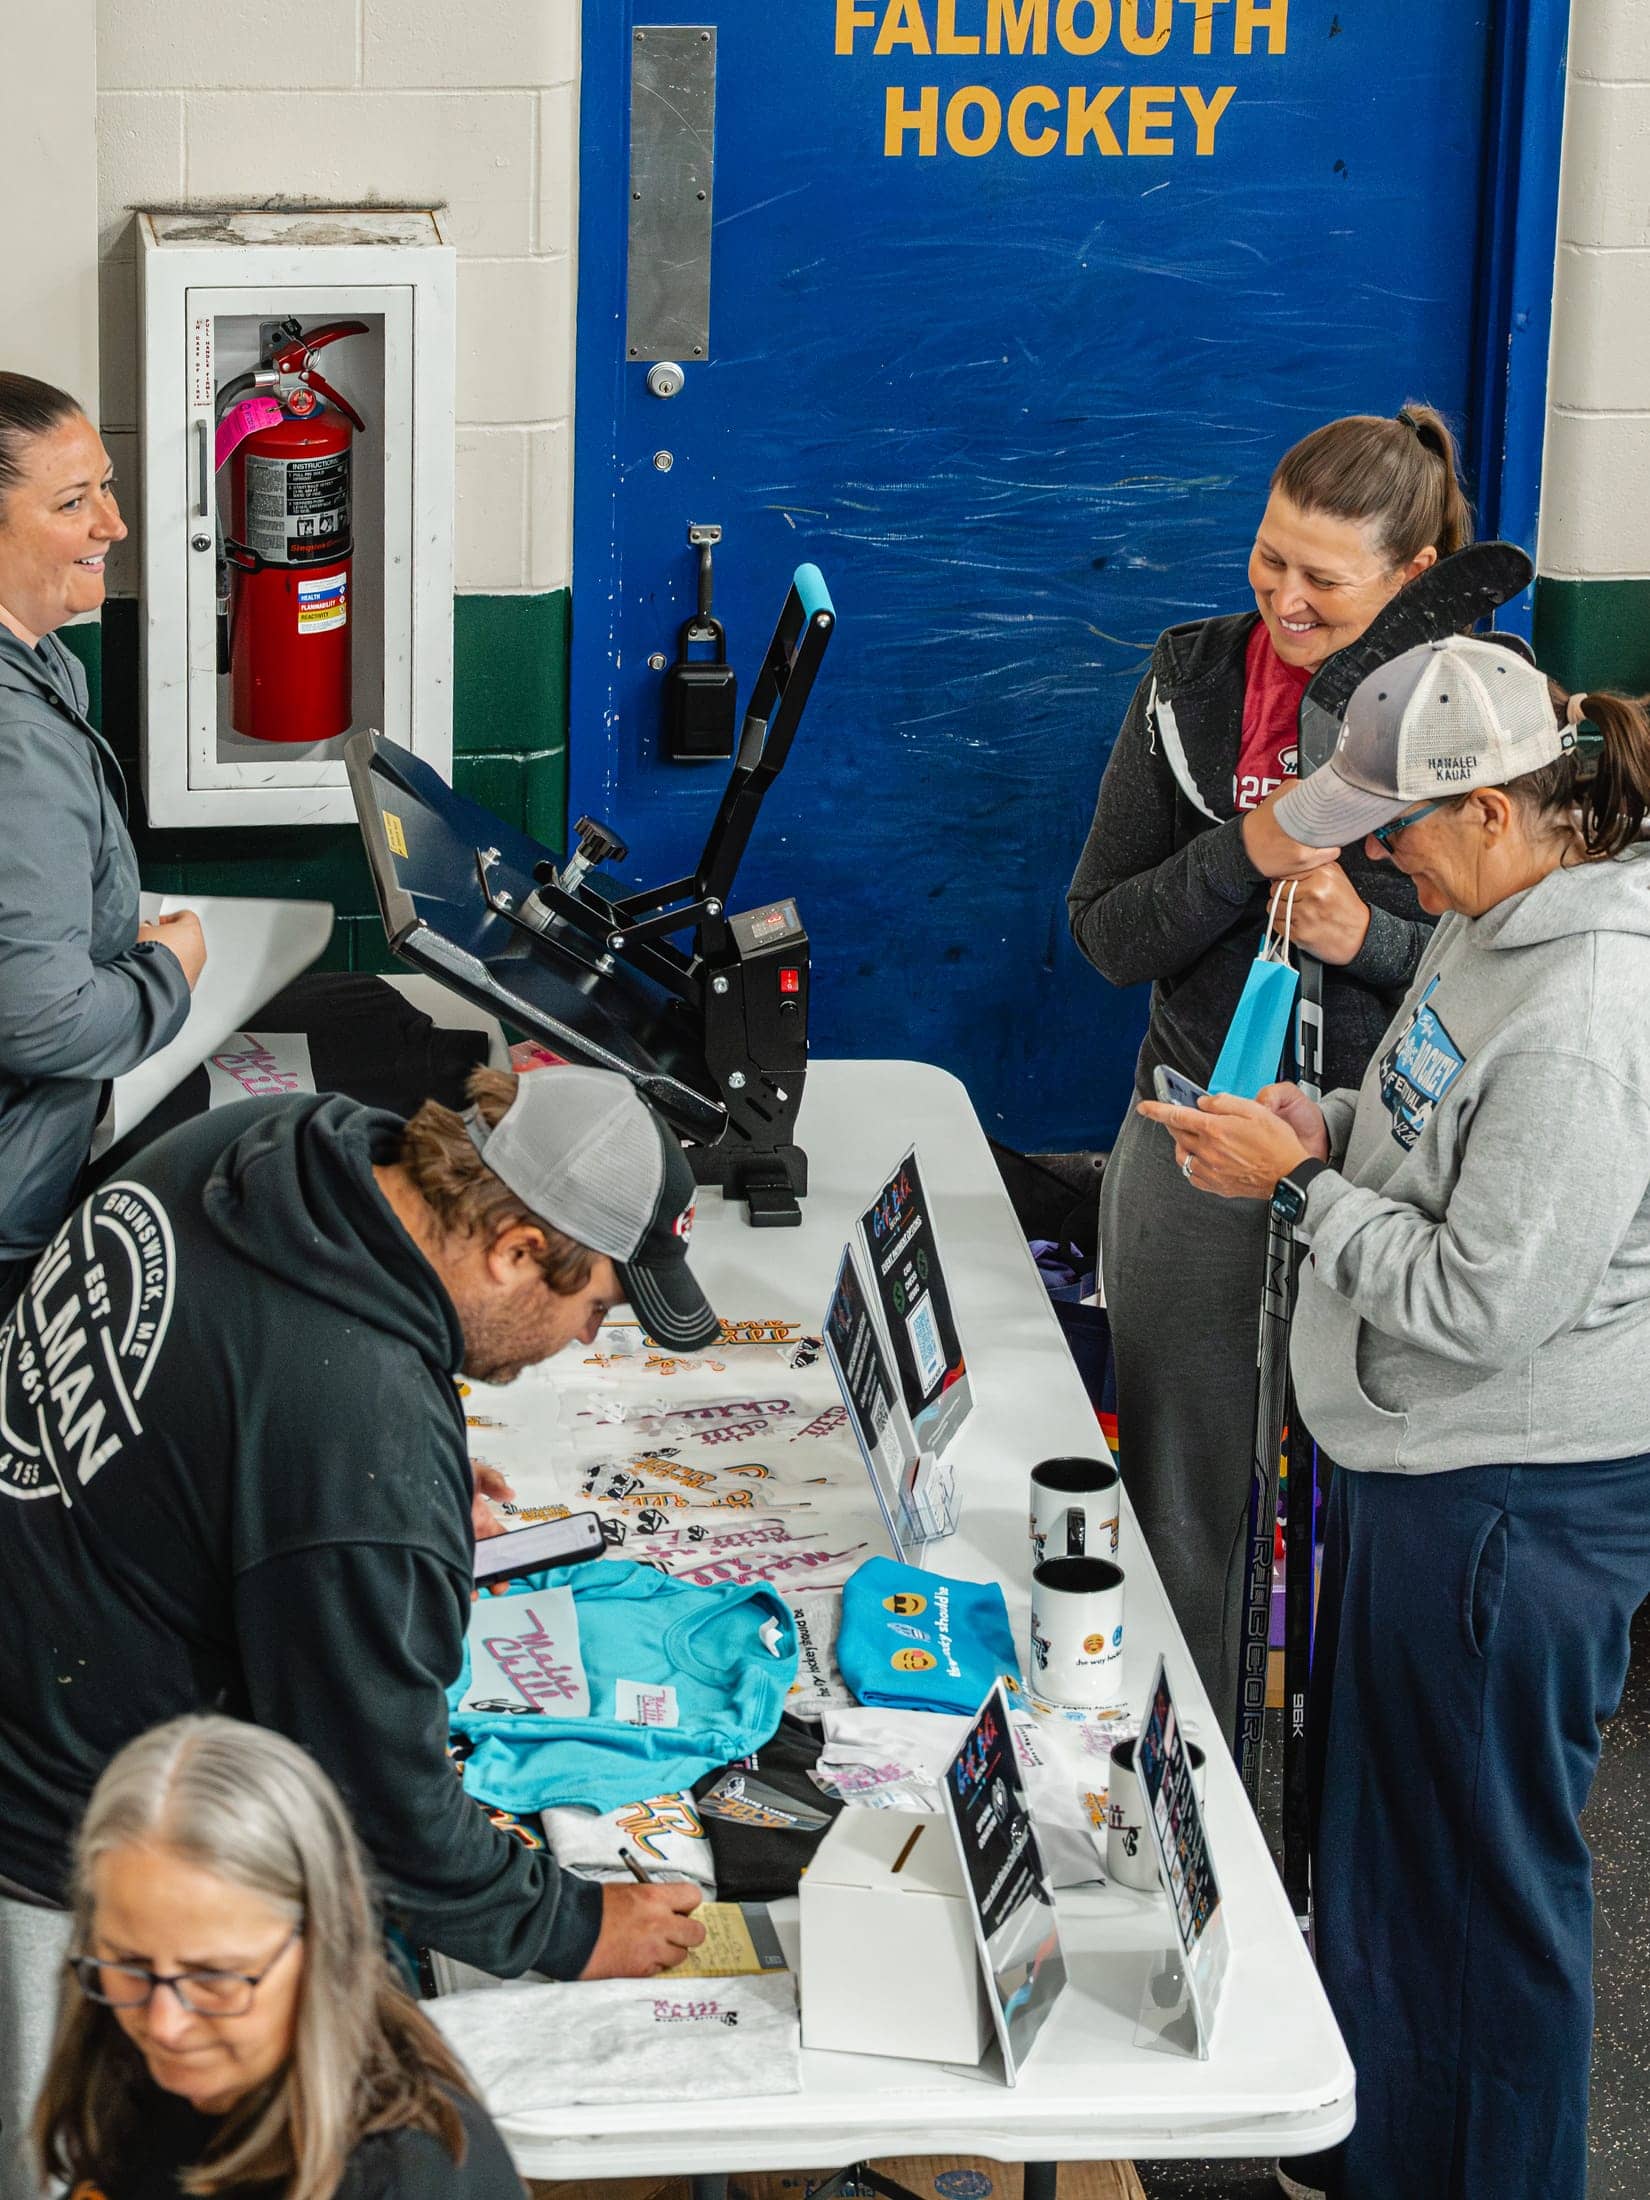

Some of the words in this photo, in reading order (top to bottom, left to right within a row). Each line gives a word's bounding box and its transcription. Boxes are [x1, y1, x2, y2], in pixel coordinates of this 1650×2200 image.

[834, 0, 1290, 56] FALMOUTH
[884, 85, 1238, 157] HOCKEY
[300, 593, 321, 601] HEALTH
[1427, 756, 1478, 771] HANALEI
[1436, 768, 1472, 781] KAUAI
[84, 1263, 111, 1320] EST
[28, 1215, 123, 1486] ILMAN
[129, 1322, 157, 1360] ME
[18, 1341, 45, 1404] 1961
[1241, 1535, 1274, 1749] RIBCOR
[1292, 1693, 1305, 1738] 96K
